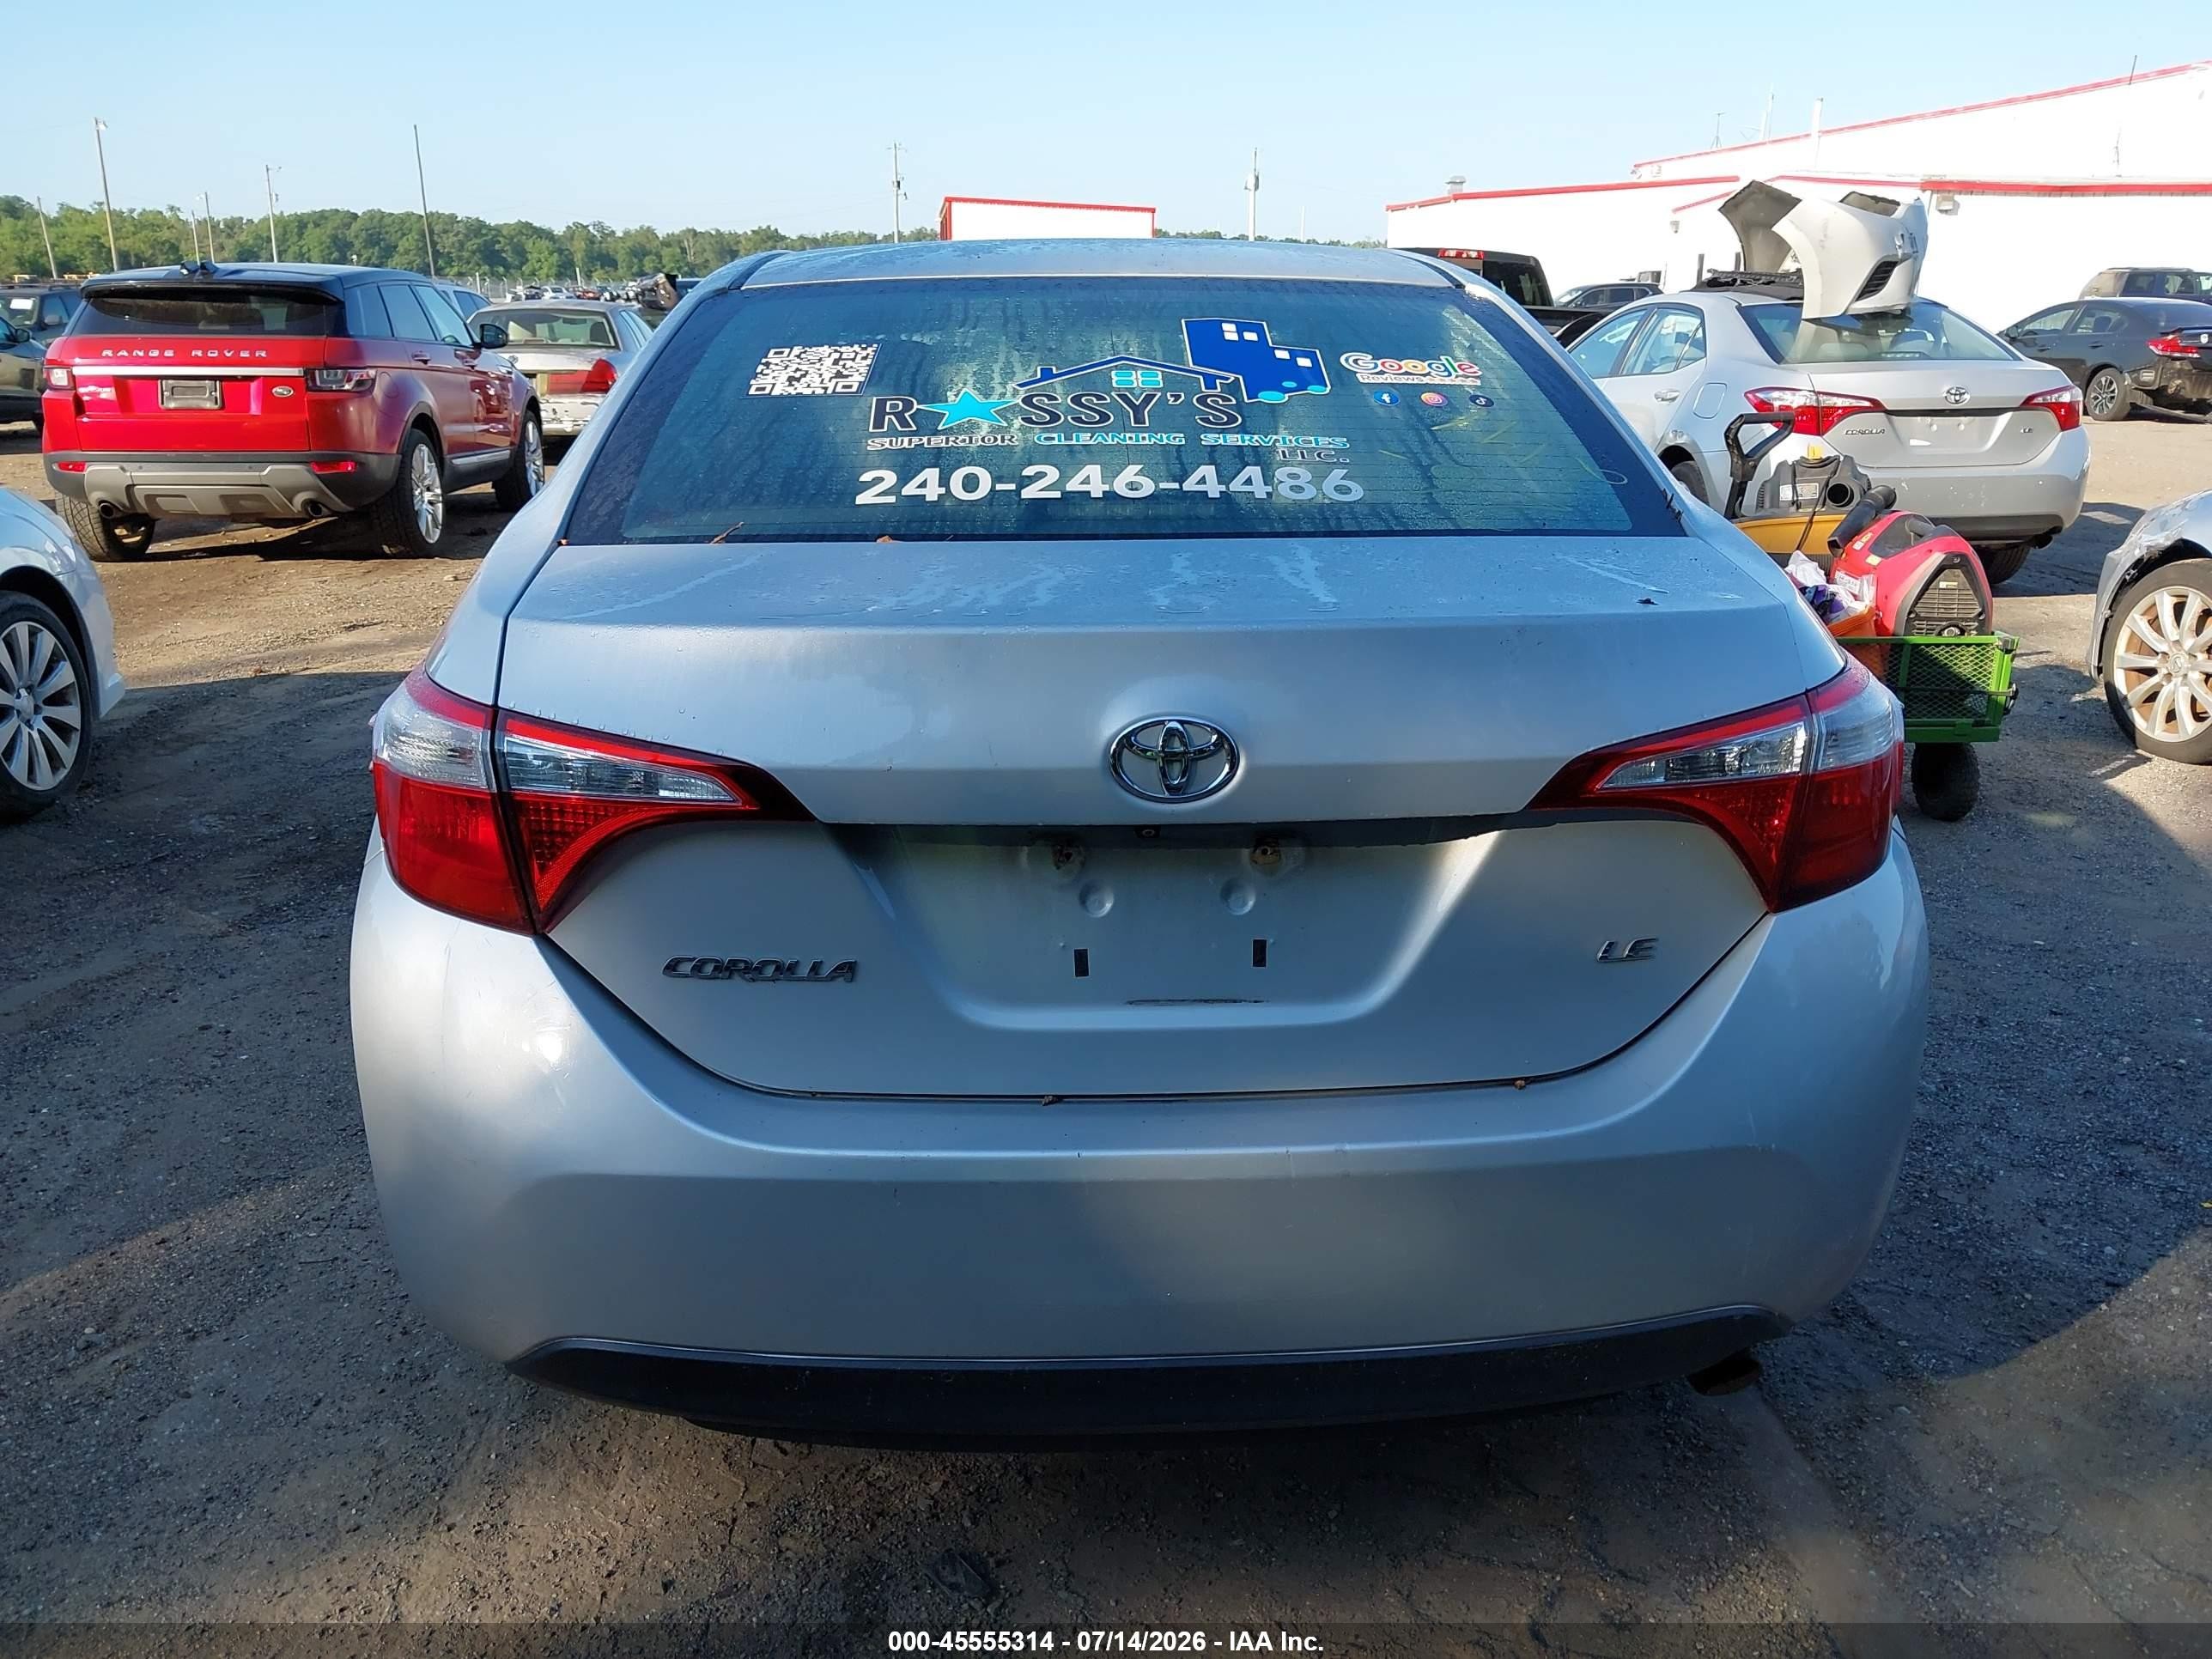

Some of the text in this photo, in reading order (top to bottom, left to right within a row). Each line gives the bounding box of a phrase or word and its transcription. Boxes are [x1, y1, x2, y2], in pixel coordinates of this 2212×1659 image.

[101, 349, 268, 357] RANGE ROVER
[1340, 352, 1483, 378] Google
[1359, 374, 1425, 383] Reviews
[868, 392, 1243, 432] RSSY'S
[866, 432, 1350, 451] SUPERIOR CLEANING SERVICES
[1277, 448, 1350, 463] LLC.
[854, 464, 1364, 505] 240-246-4486
[1596, 937, 1657, 963] LE
[661, 955, 857, 983] COROLLA
